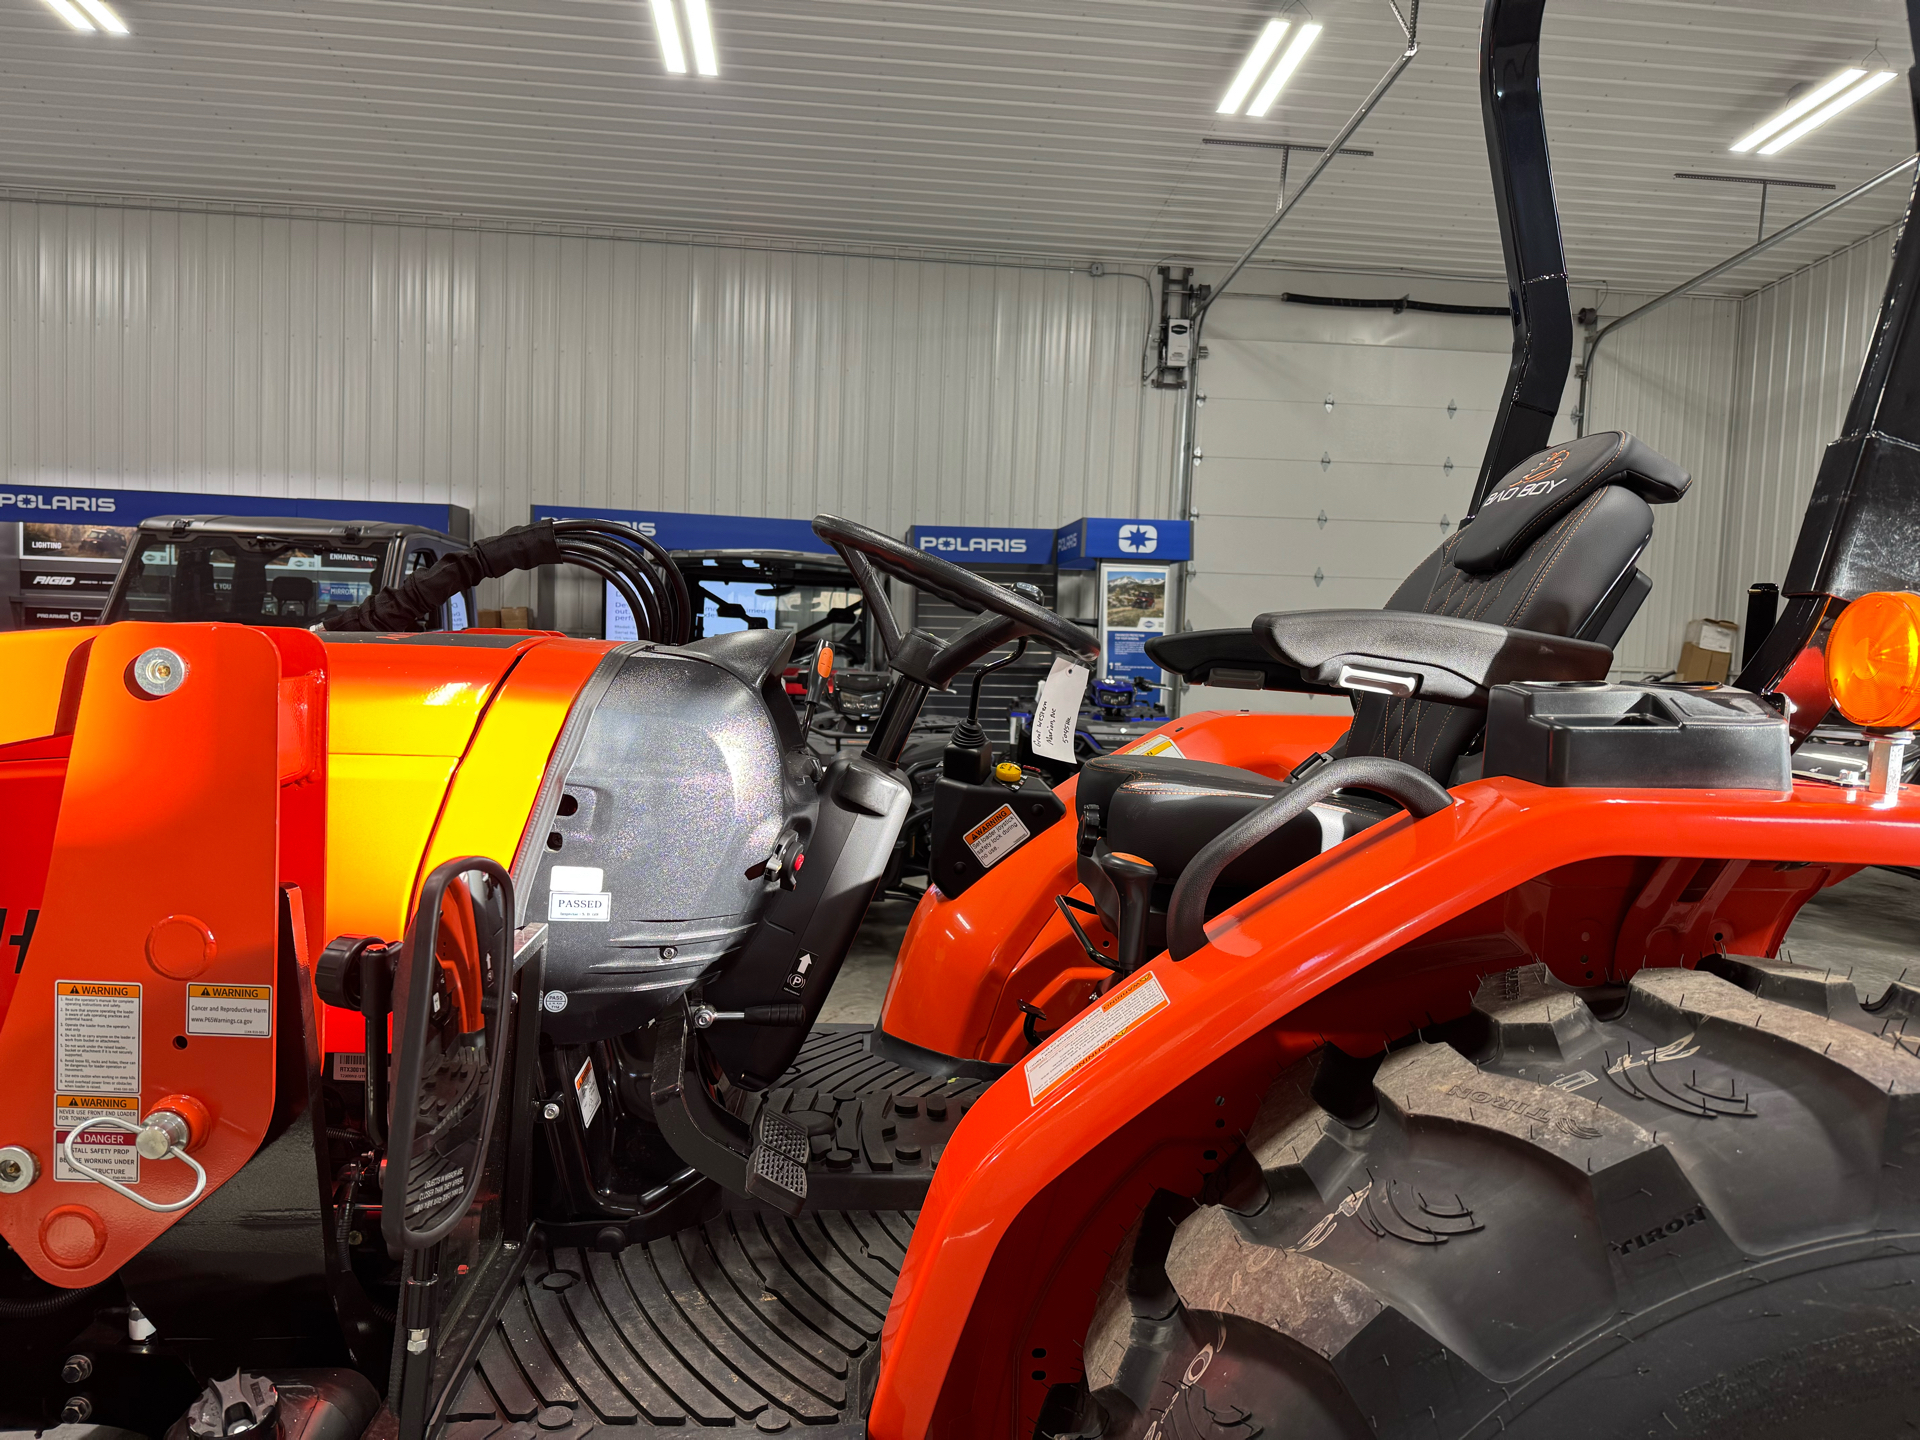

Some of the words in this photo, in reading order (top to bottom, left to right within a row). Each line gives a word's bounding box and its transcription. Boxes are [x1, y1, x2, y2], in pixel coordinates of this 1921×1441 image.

[1483, 486, 1516, 508] BAD
[1518, 478, 1568, 497] BOY
[0, 494, 116, 512] POLARIS
[32, 541, 62, 550] LIGHTING
[920, 536, 1028, 553] POLARIS
[330, 553, 360, 562] ENHANCE
[32, 576, 76, 586] RIGID
[975, 810, 1008, 836] WARNING
[972, 840, 982, 850] Set
[981, 829, 997, 843] loader
[996, 816, 1014, 833] joystick
[976, 842, 992, 855] safety
[992, 833, 1002, 844] lock
[1002, 822, 1018, 836] during
[558, 899, 602, 908] PASSED
[81, 986, 128, 996] WARNING
[212, 988, 258, 998] WARNING
[191, 1016, 252, 1025] www.P65Warnings.ca.gov
[80, 1098, 127, 1108] WARNING
[1448, 1082, 1553, 1126] TIRON
[84, 1134, 124, 1144] DANGER
[1611, 1205, 1708, 1258] TIRON
